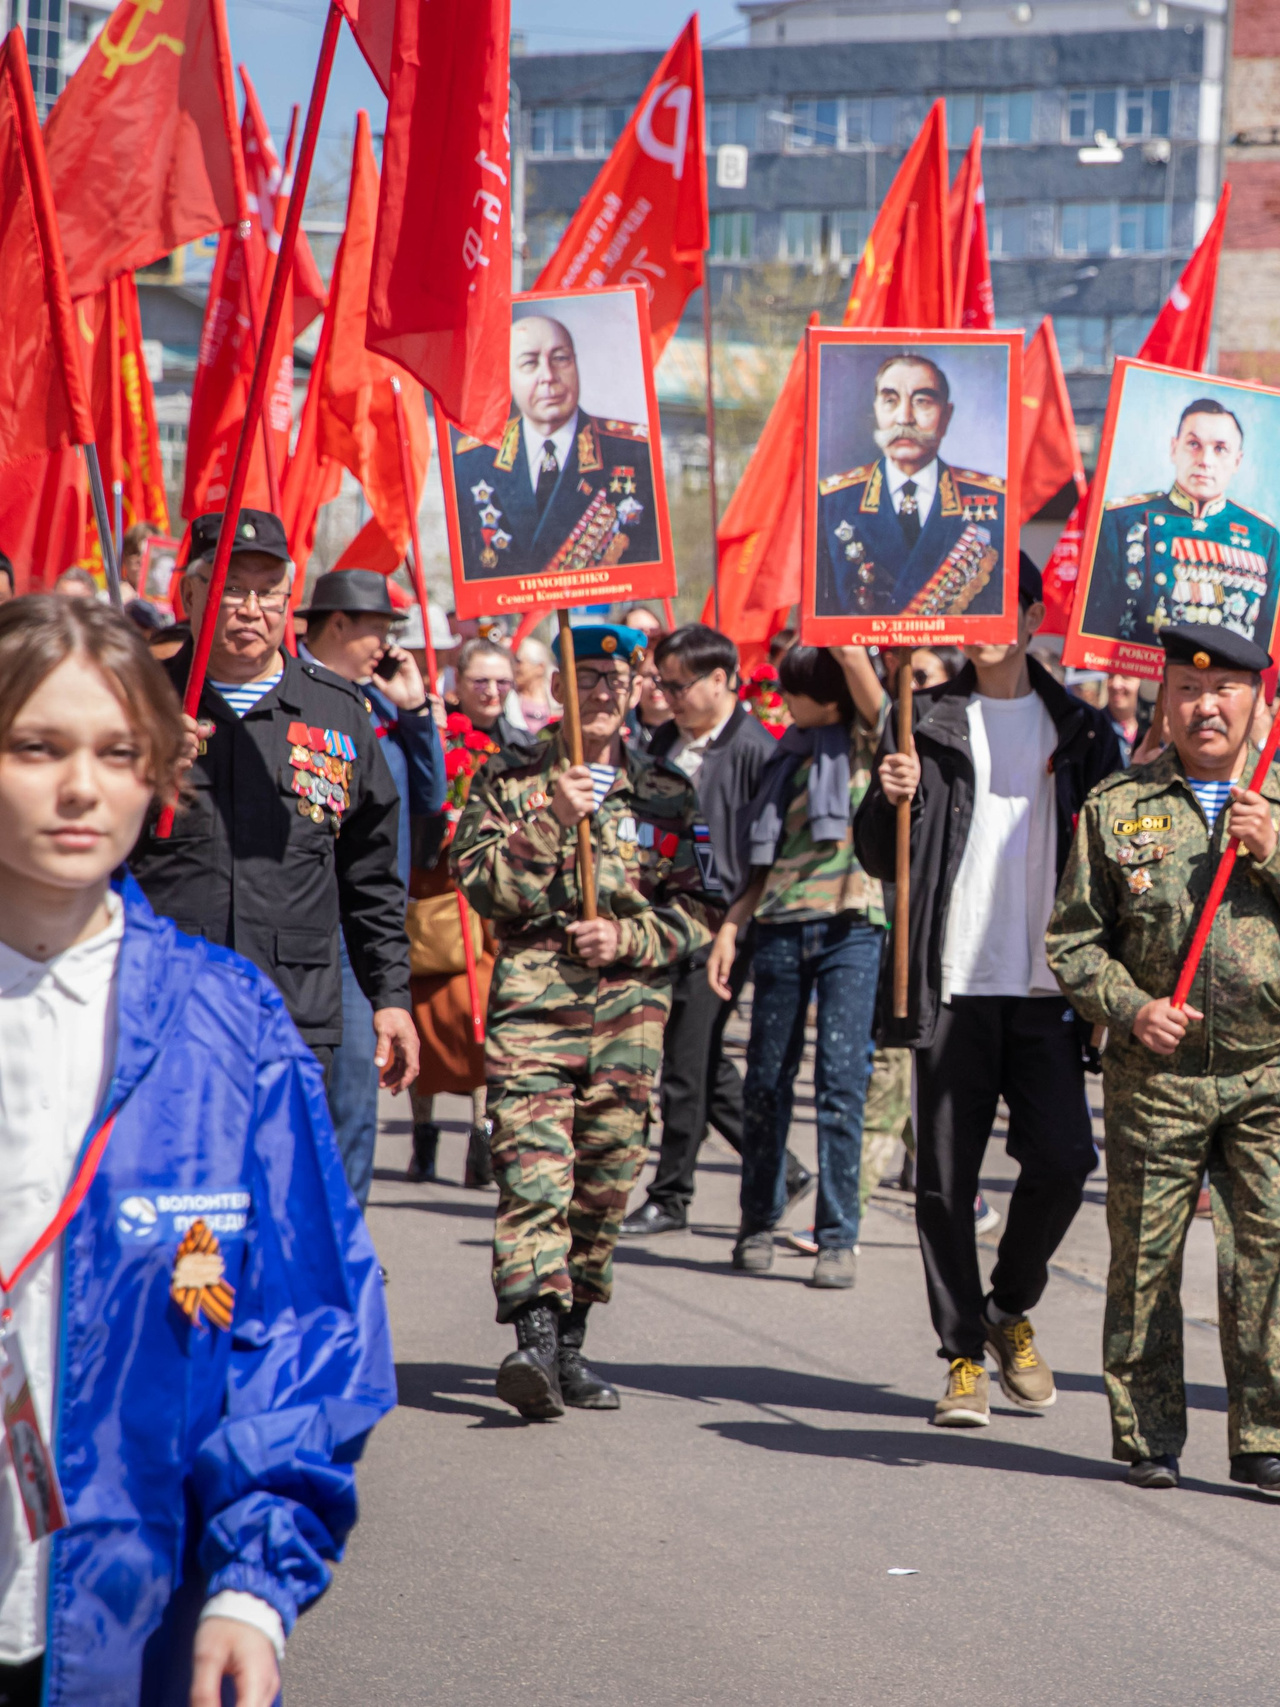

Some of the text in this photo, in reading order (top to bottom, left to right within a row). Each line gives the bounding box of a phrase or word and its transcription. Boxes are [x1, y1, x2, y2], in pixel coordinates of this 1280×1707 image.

[517, 571, 610, 591] ТИМОШЕНКО
[535, 583, 633, 602] Константинович
[872, 619, 945, 632] БУДЕННЫЙ
[891, 632, 965, 644] Михайлович
